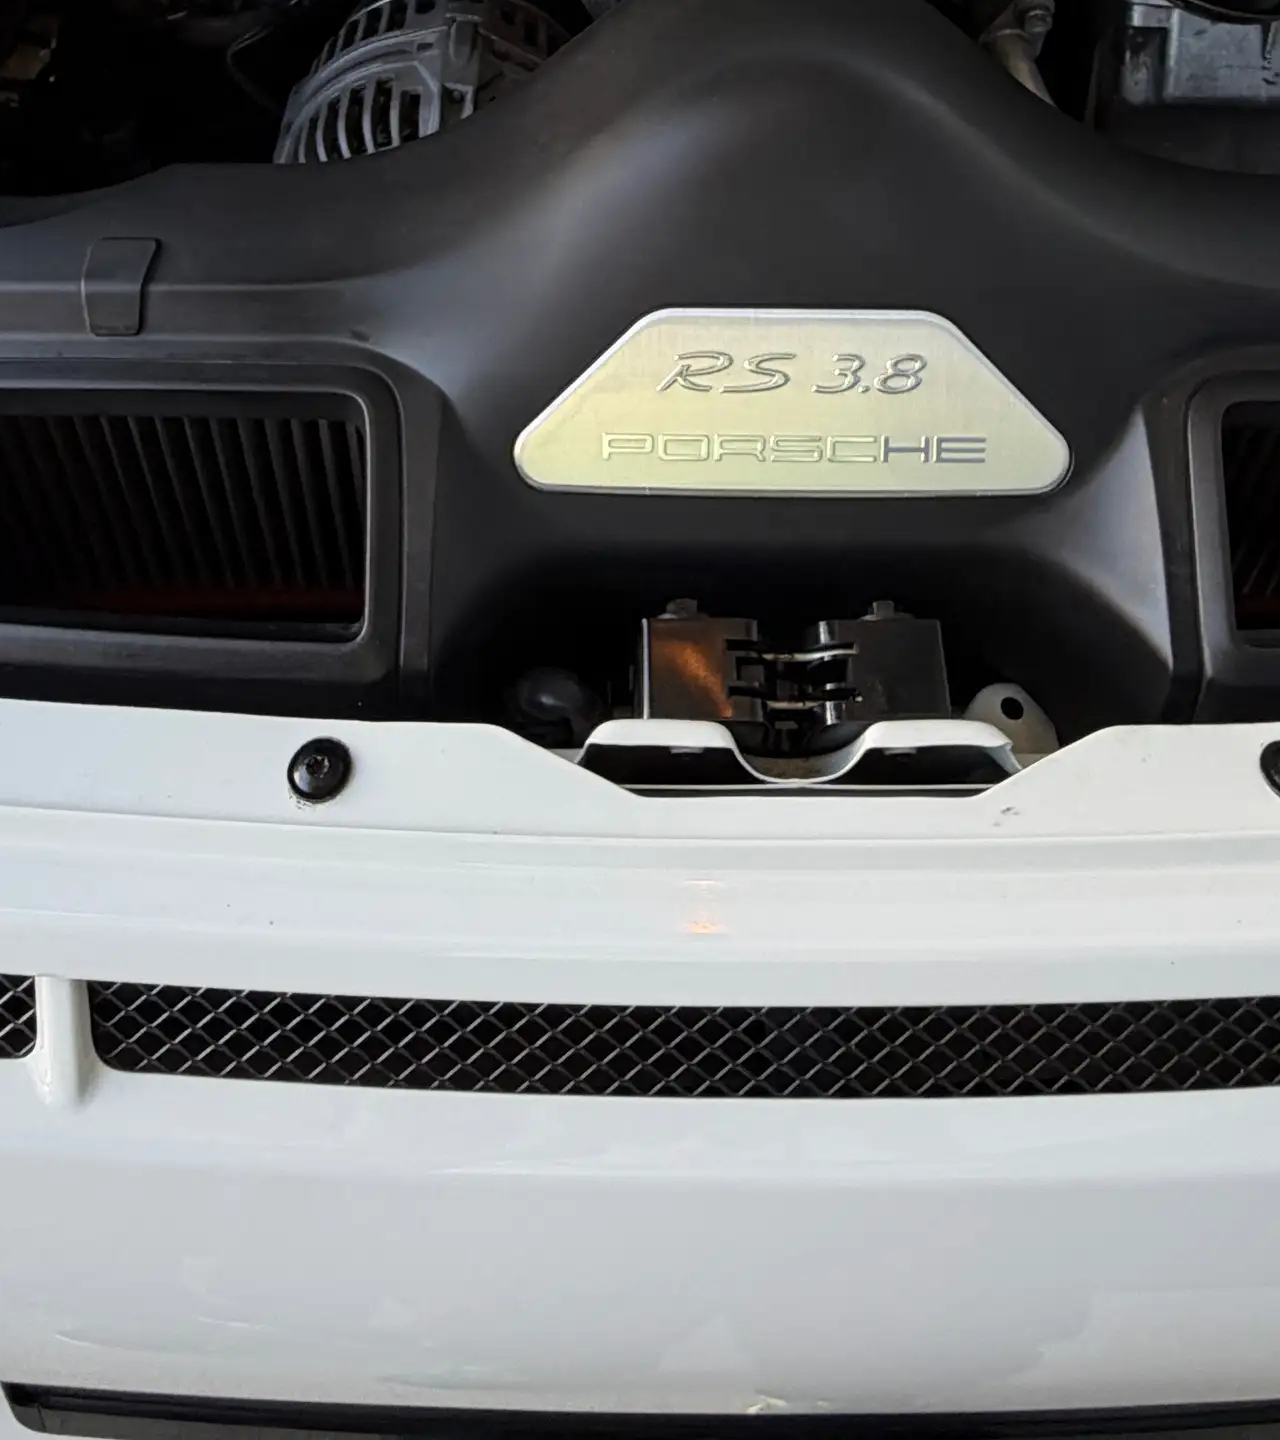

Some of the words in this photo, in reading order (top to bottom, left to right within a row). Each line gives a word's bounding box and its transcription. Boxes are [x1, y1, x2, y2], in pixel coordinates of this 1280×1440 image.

[656, 350, 798, 393] RS
[811, 352, 928, 395] 3.8
[601, 432, 988, 464] PORSCHE
